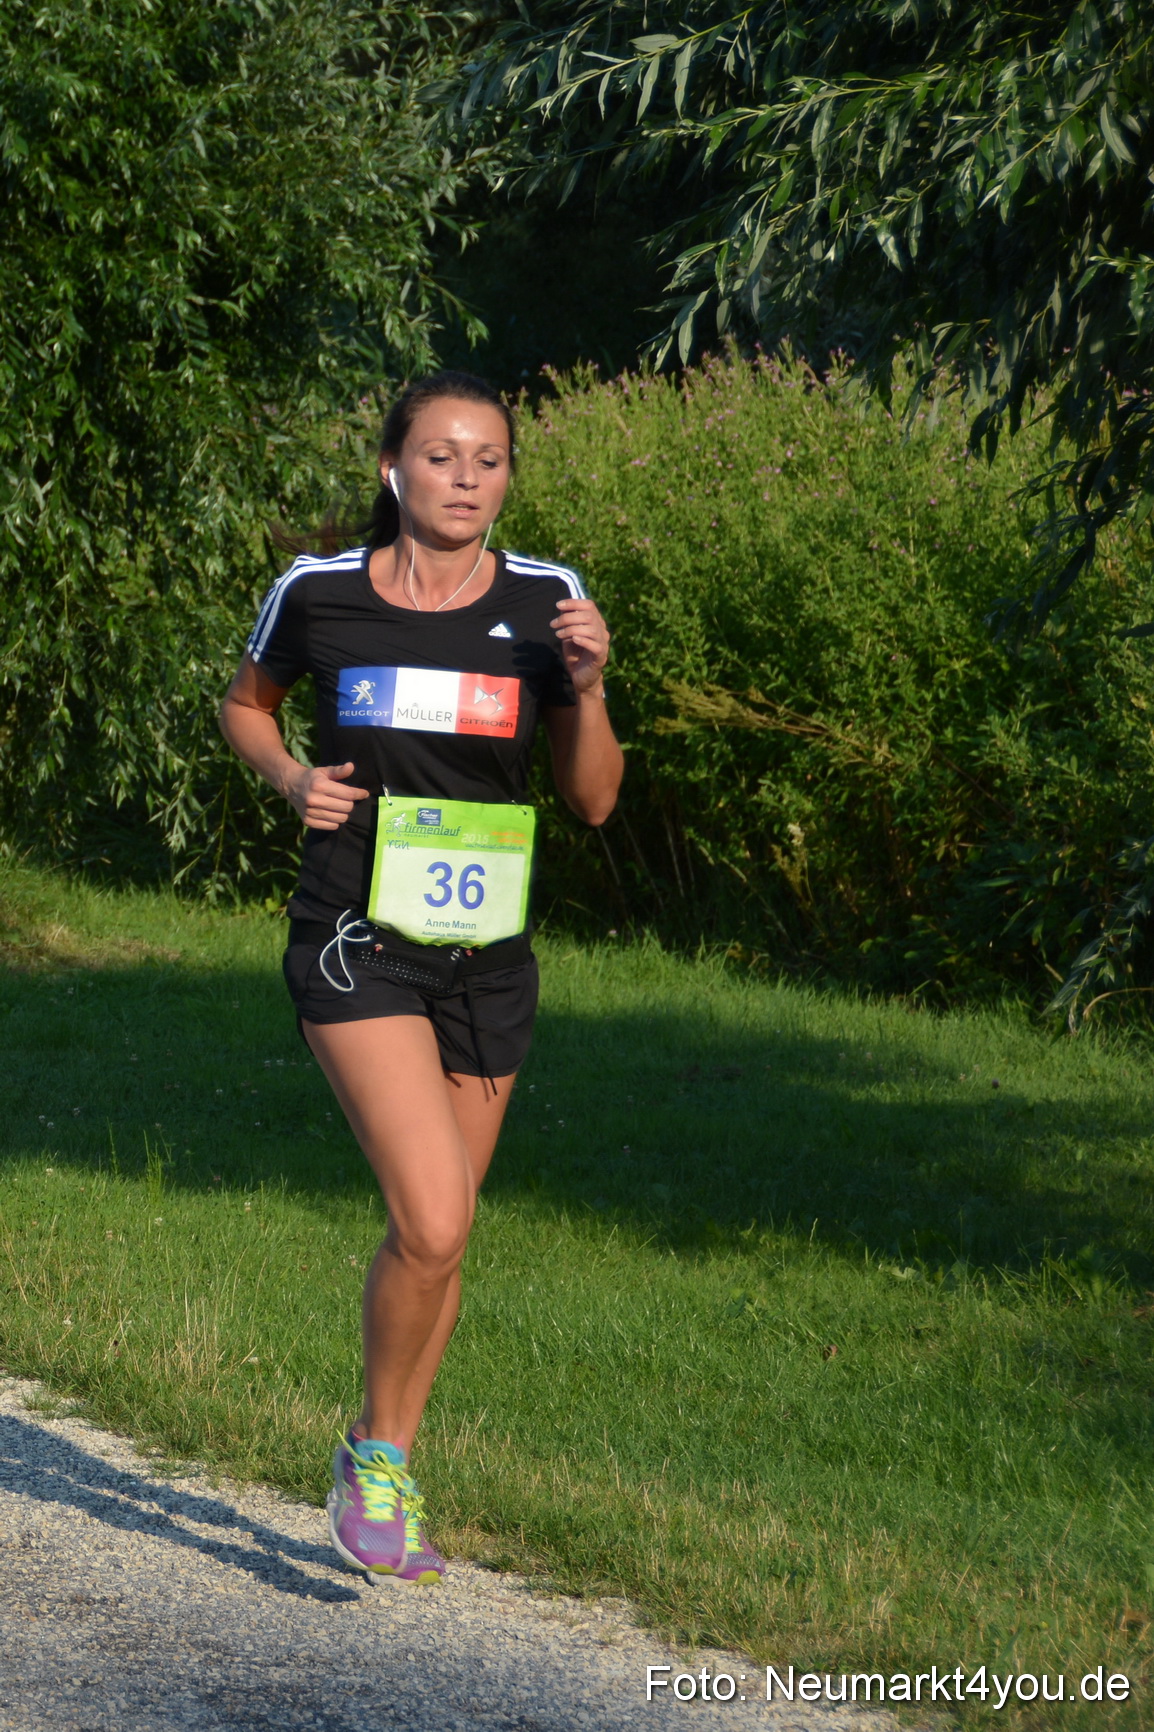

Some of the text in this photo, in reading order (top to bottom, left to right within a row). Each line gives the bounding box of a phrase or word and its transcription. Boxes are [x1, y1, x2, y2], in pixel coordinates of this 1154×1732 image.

[404, 822, 462, 837] firmenlauf
[461, 833, 489, 844] 2015
[423, 861, 486, 910] 36
[425, 918, 477, 930] Anne Mann
